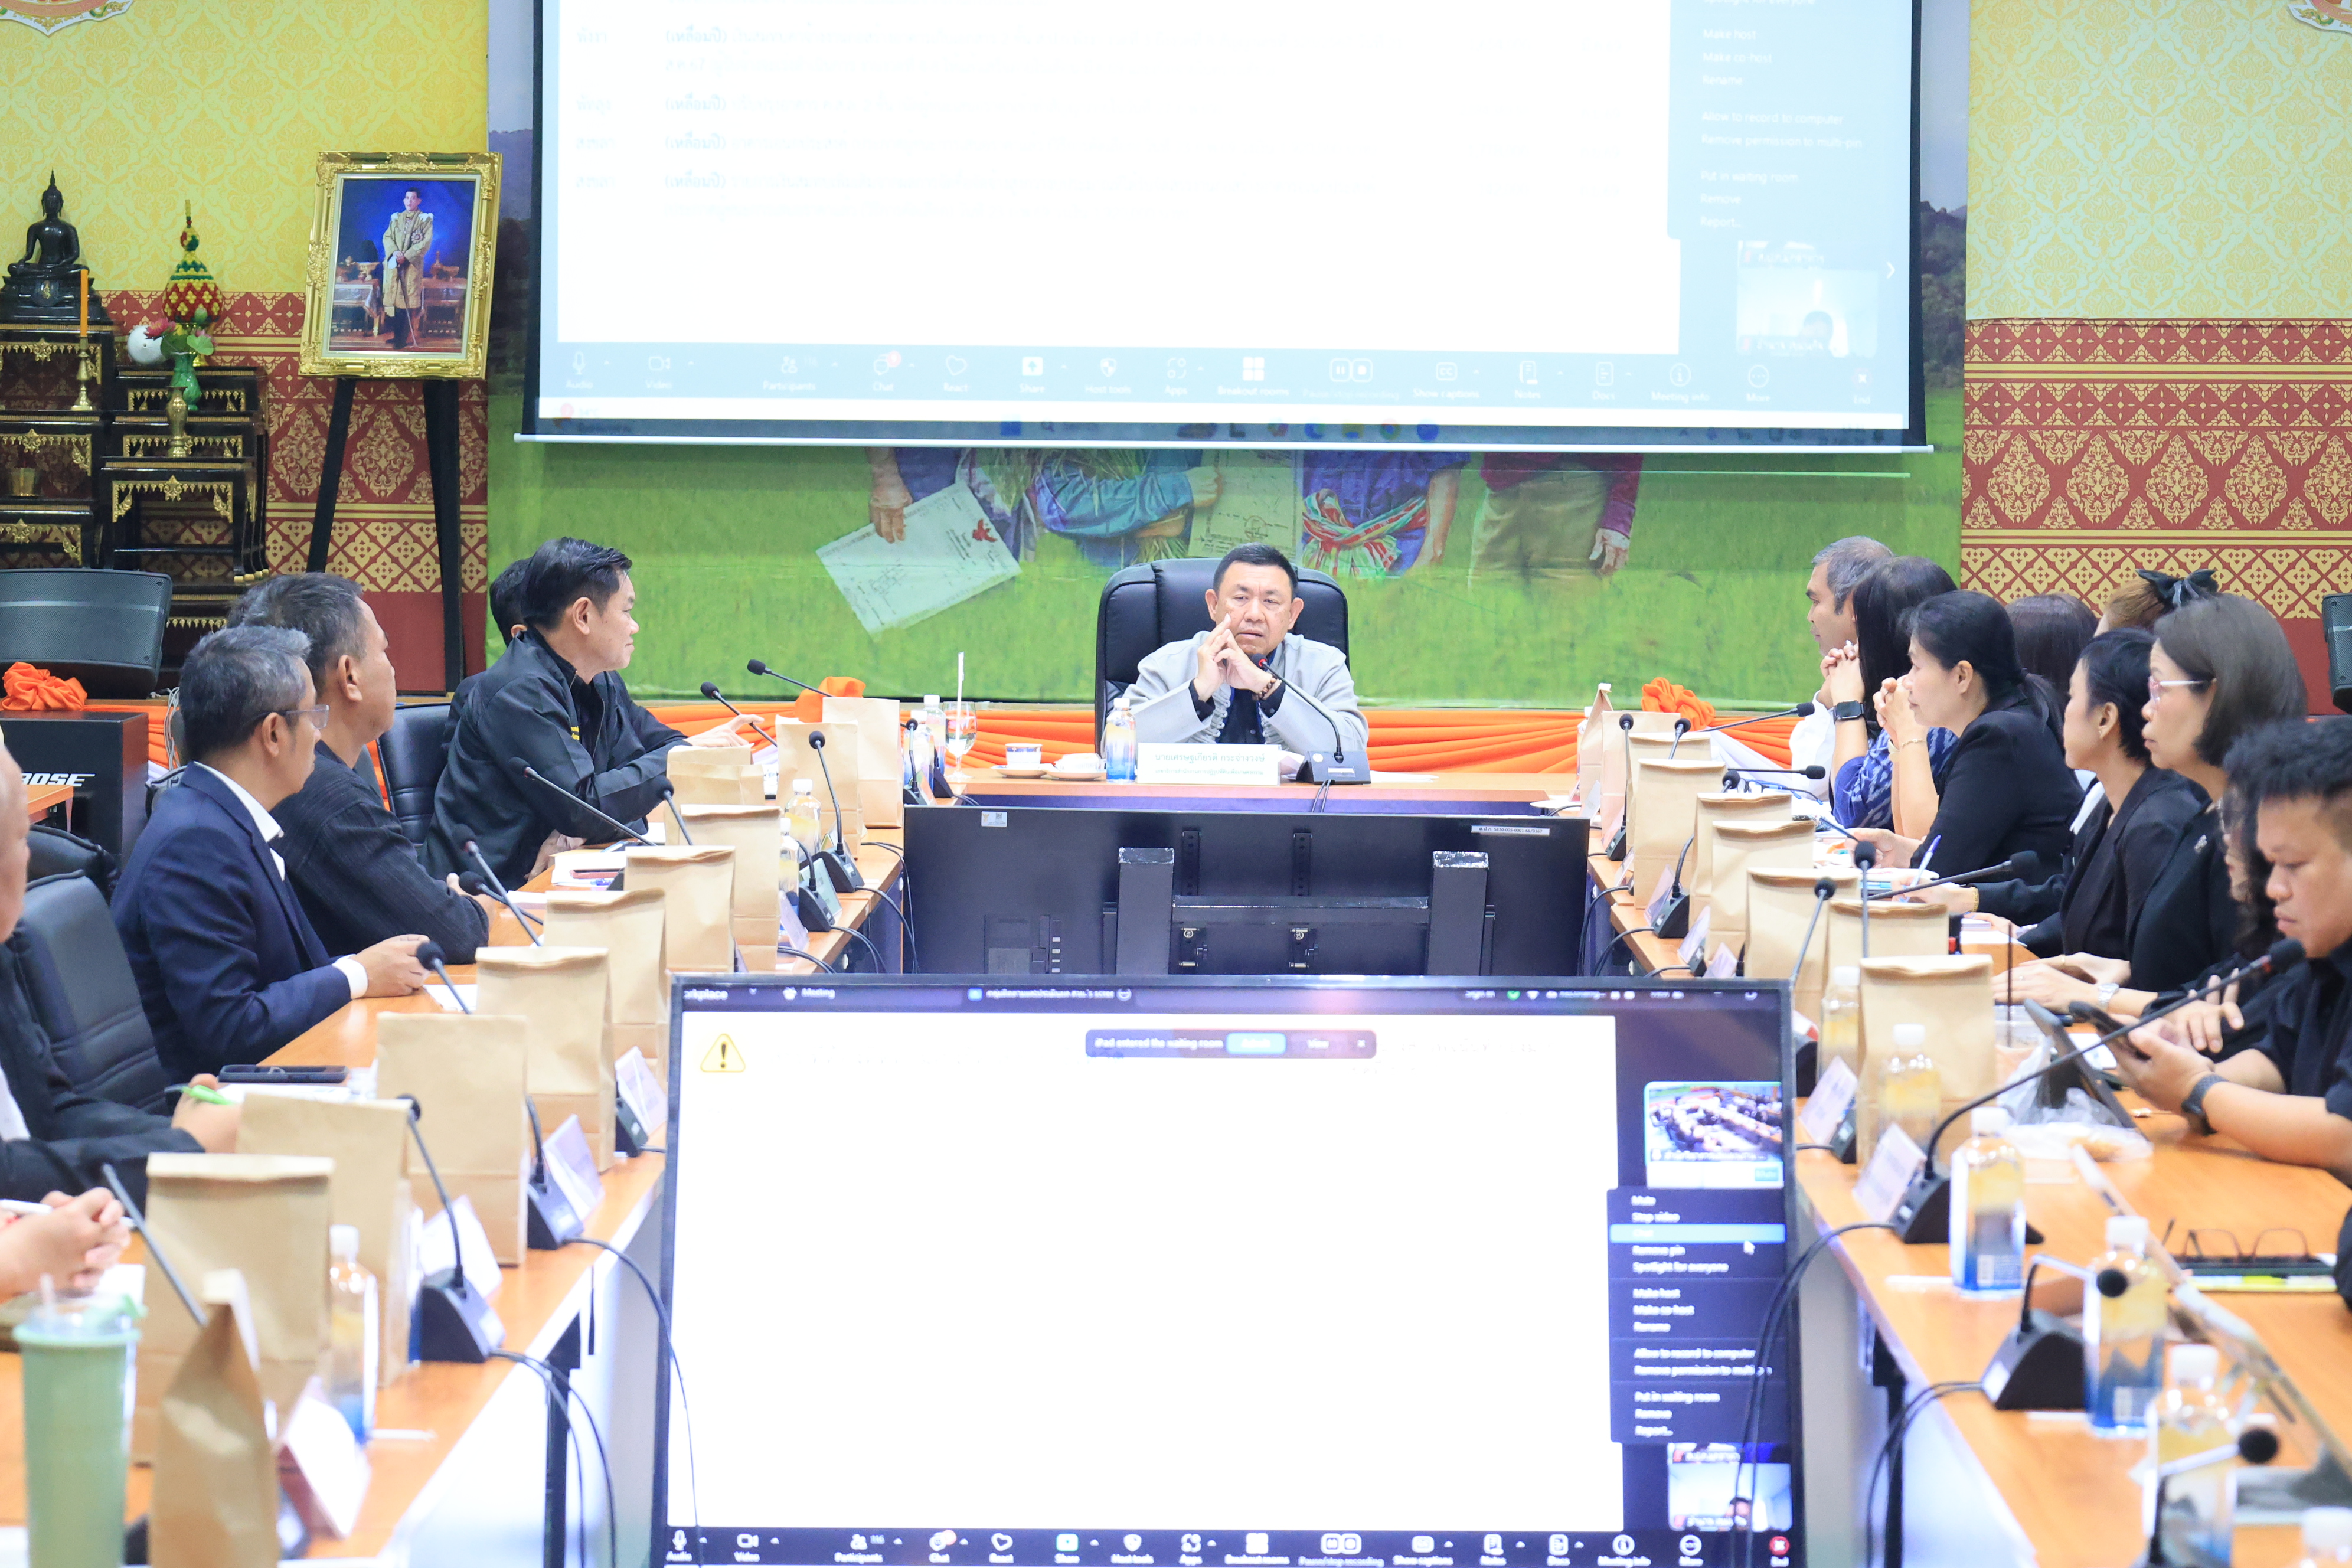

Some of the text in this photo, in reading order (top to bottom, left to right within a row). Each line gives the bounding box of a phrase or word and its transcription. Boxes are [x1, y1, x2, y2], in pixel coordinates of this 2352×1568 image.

[1703, 28, 1756, 40] Make host
[1703, 52, 1772, 64] Make co-host
[1702, 75, 1744, 85] Rename
[1701, 111, 1845, 126] Allow to record to computer
[1701, 135, 1742, 145] Remove
[1745, 136, 1801, 147] permission
[1804, 138, 1814, 146] to
[1701, 171, 1799, 184] Put in waiting room
[1700, 194, 1742, 204] Remove
[566, 379, 593, 390] Audio
[646, 380, 672, 390] Video
[763, 380, 816, 391] Participants
[873, 381, 894, 392] Chat
[944, 381, 969, 393] React
[1020, 383, 1045, 394] Share
[1086, 385, 1131, 395] Host tools
[1165, 385, 1187, 397] Apps
[1218, 386, 1289, 397] Breakout rooms
[1413, 388, 1480, 400] Show captions
[1514, 389, 1541, 400] Notes
[1593, 390, 1615, 400] Docs
[1651, 391, 1710, 404] Meeting info
[1746, 393, 1770, 402] More
[801, 988, 835, 999] Meeting
[1095, 1037, 1223, 1050] iPad entered the waiting room
[1308, 1038, 1329, 1049] View
[1299, 1556, 1384, 1568] Pause/stop recording
